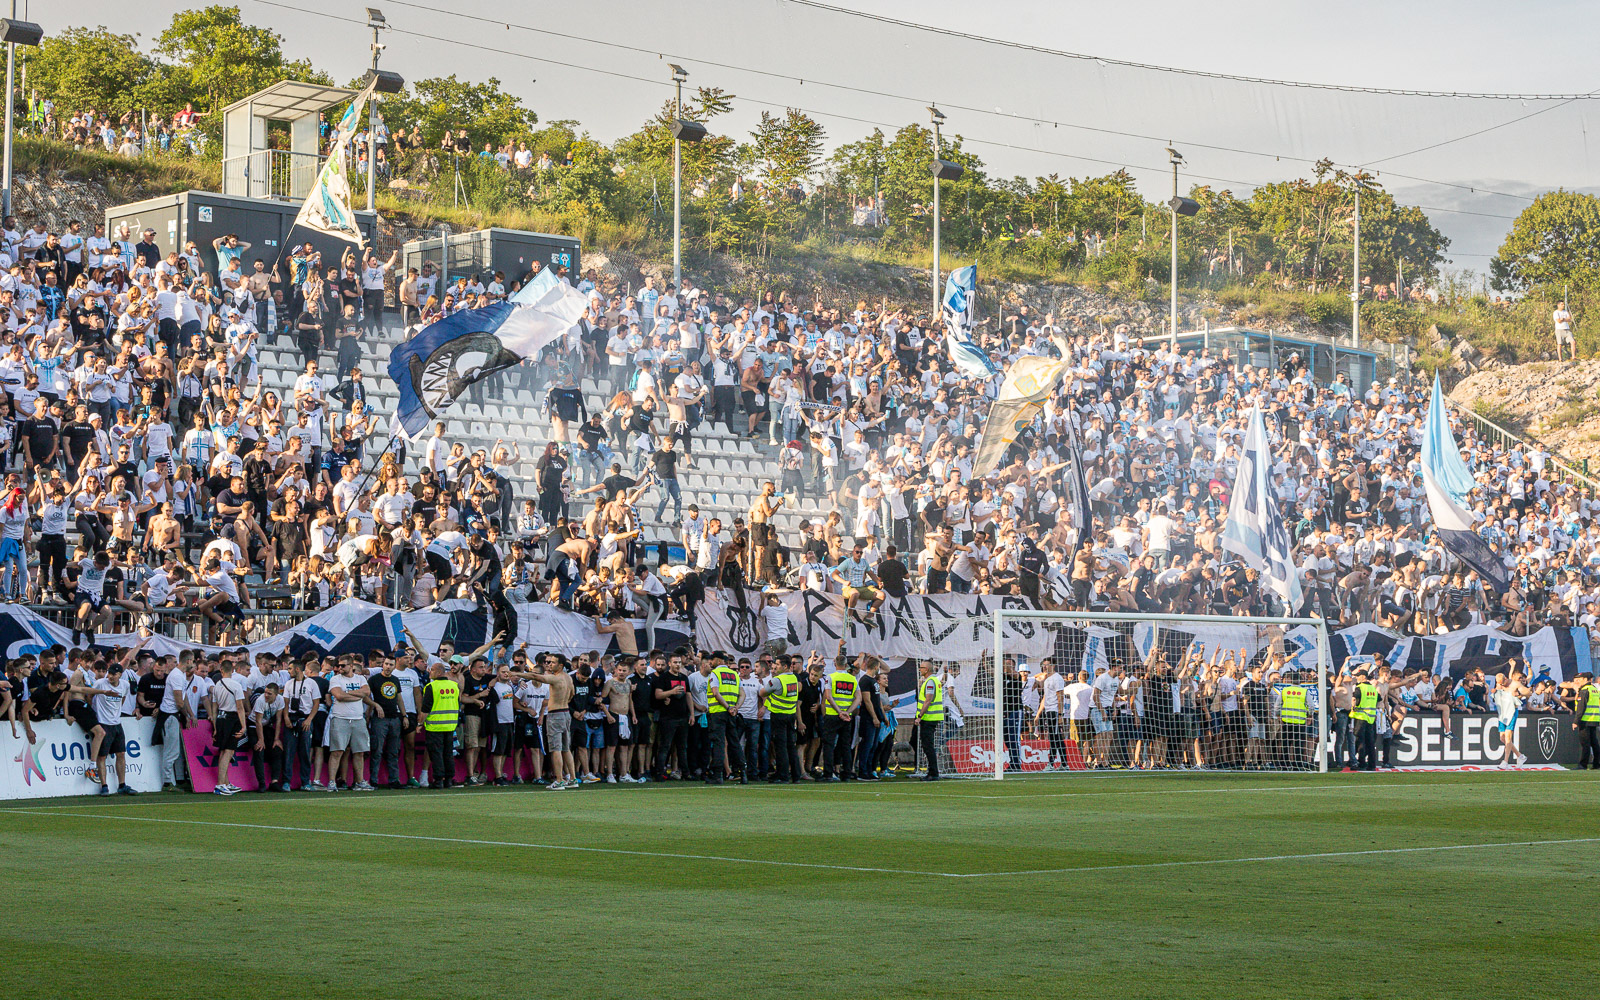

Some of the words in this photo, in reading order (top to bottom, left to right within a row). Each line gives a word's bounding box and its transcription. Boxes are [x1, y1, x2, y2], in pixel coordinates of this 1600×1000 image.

[786, 587, 1010, 646] RMADA
[51, 734, 141, 761] unie
[1397, 716, 1528, 762] SELECT
